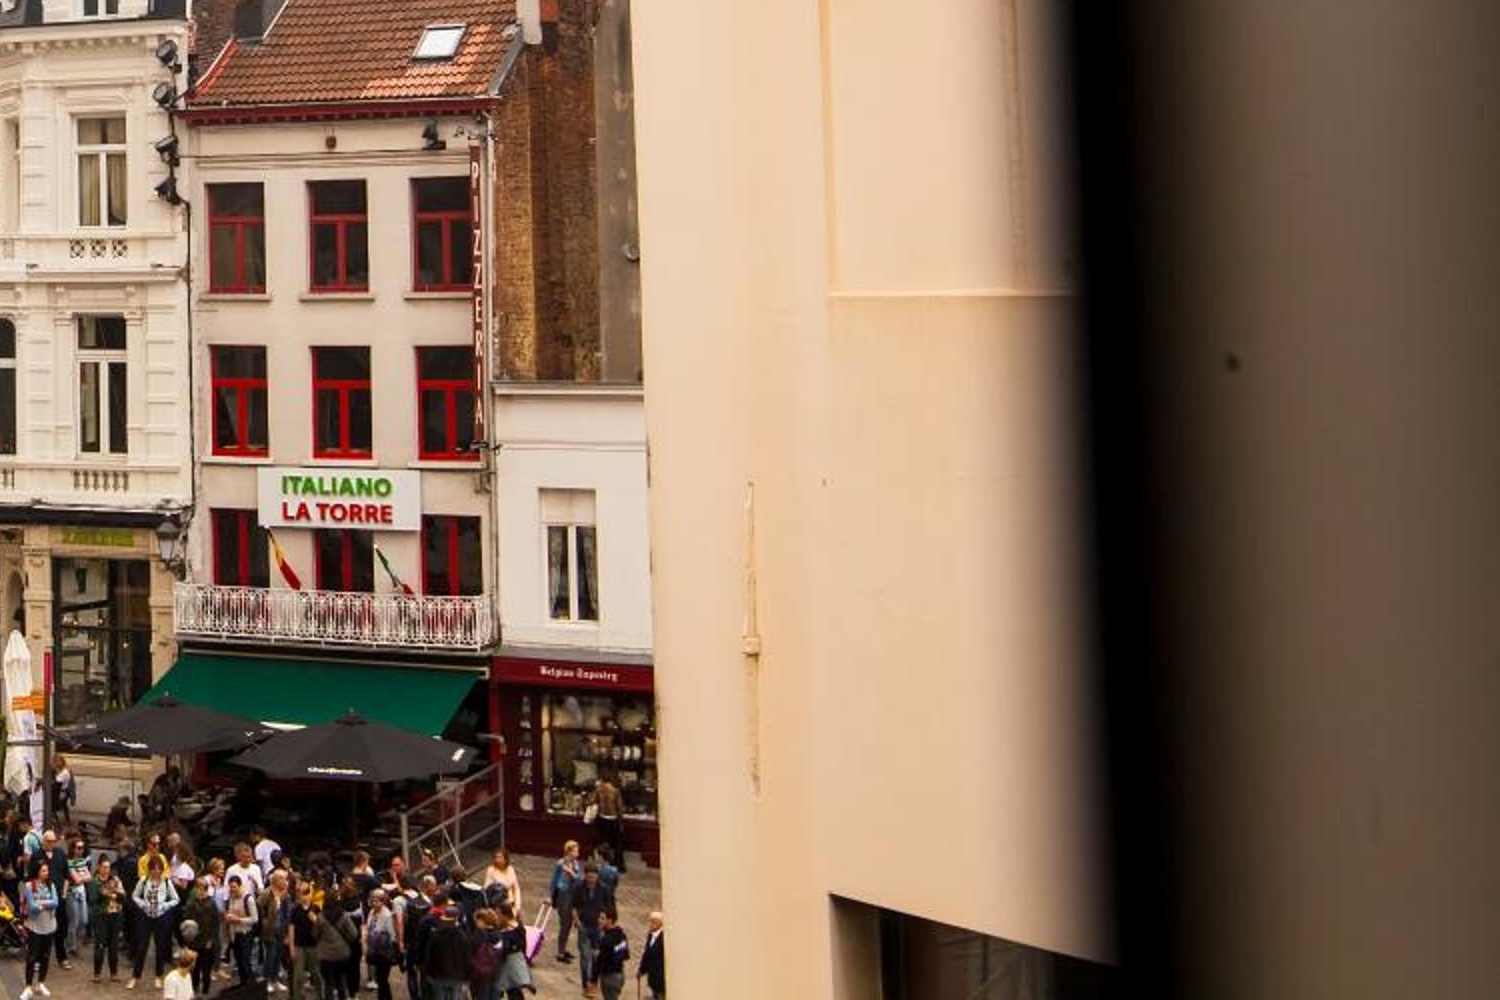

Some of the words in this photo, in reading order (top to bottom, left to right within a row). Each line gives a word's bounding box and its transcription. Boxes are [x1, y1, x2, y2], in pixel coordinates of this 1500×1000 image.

[471, 161, 483, 424] PIZZERIA
[282, 476, 392, 497] ITALIANO
[282, 502, 311, 521] LA
[316, 503, 393, 523] TORRE
